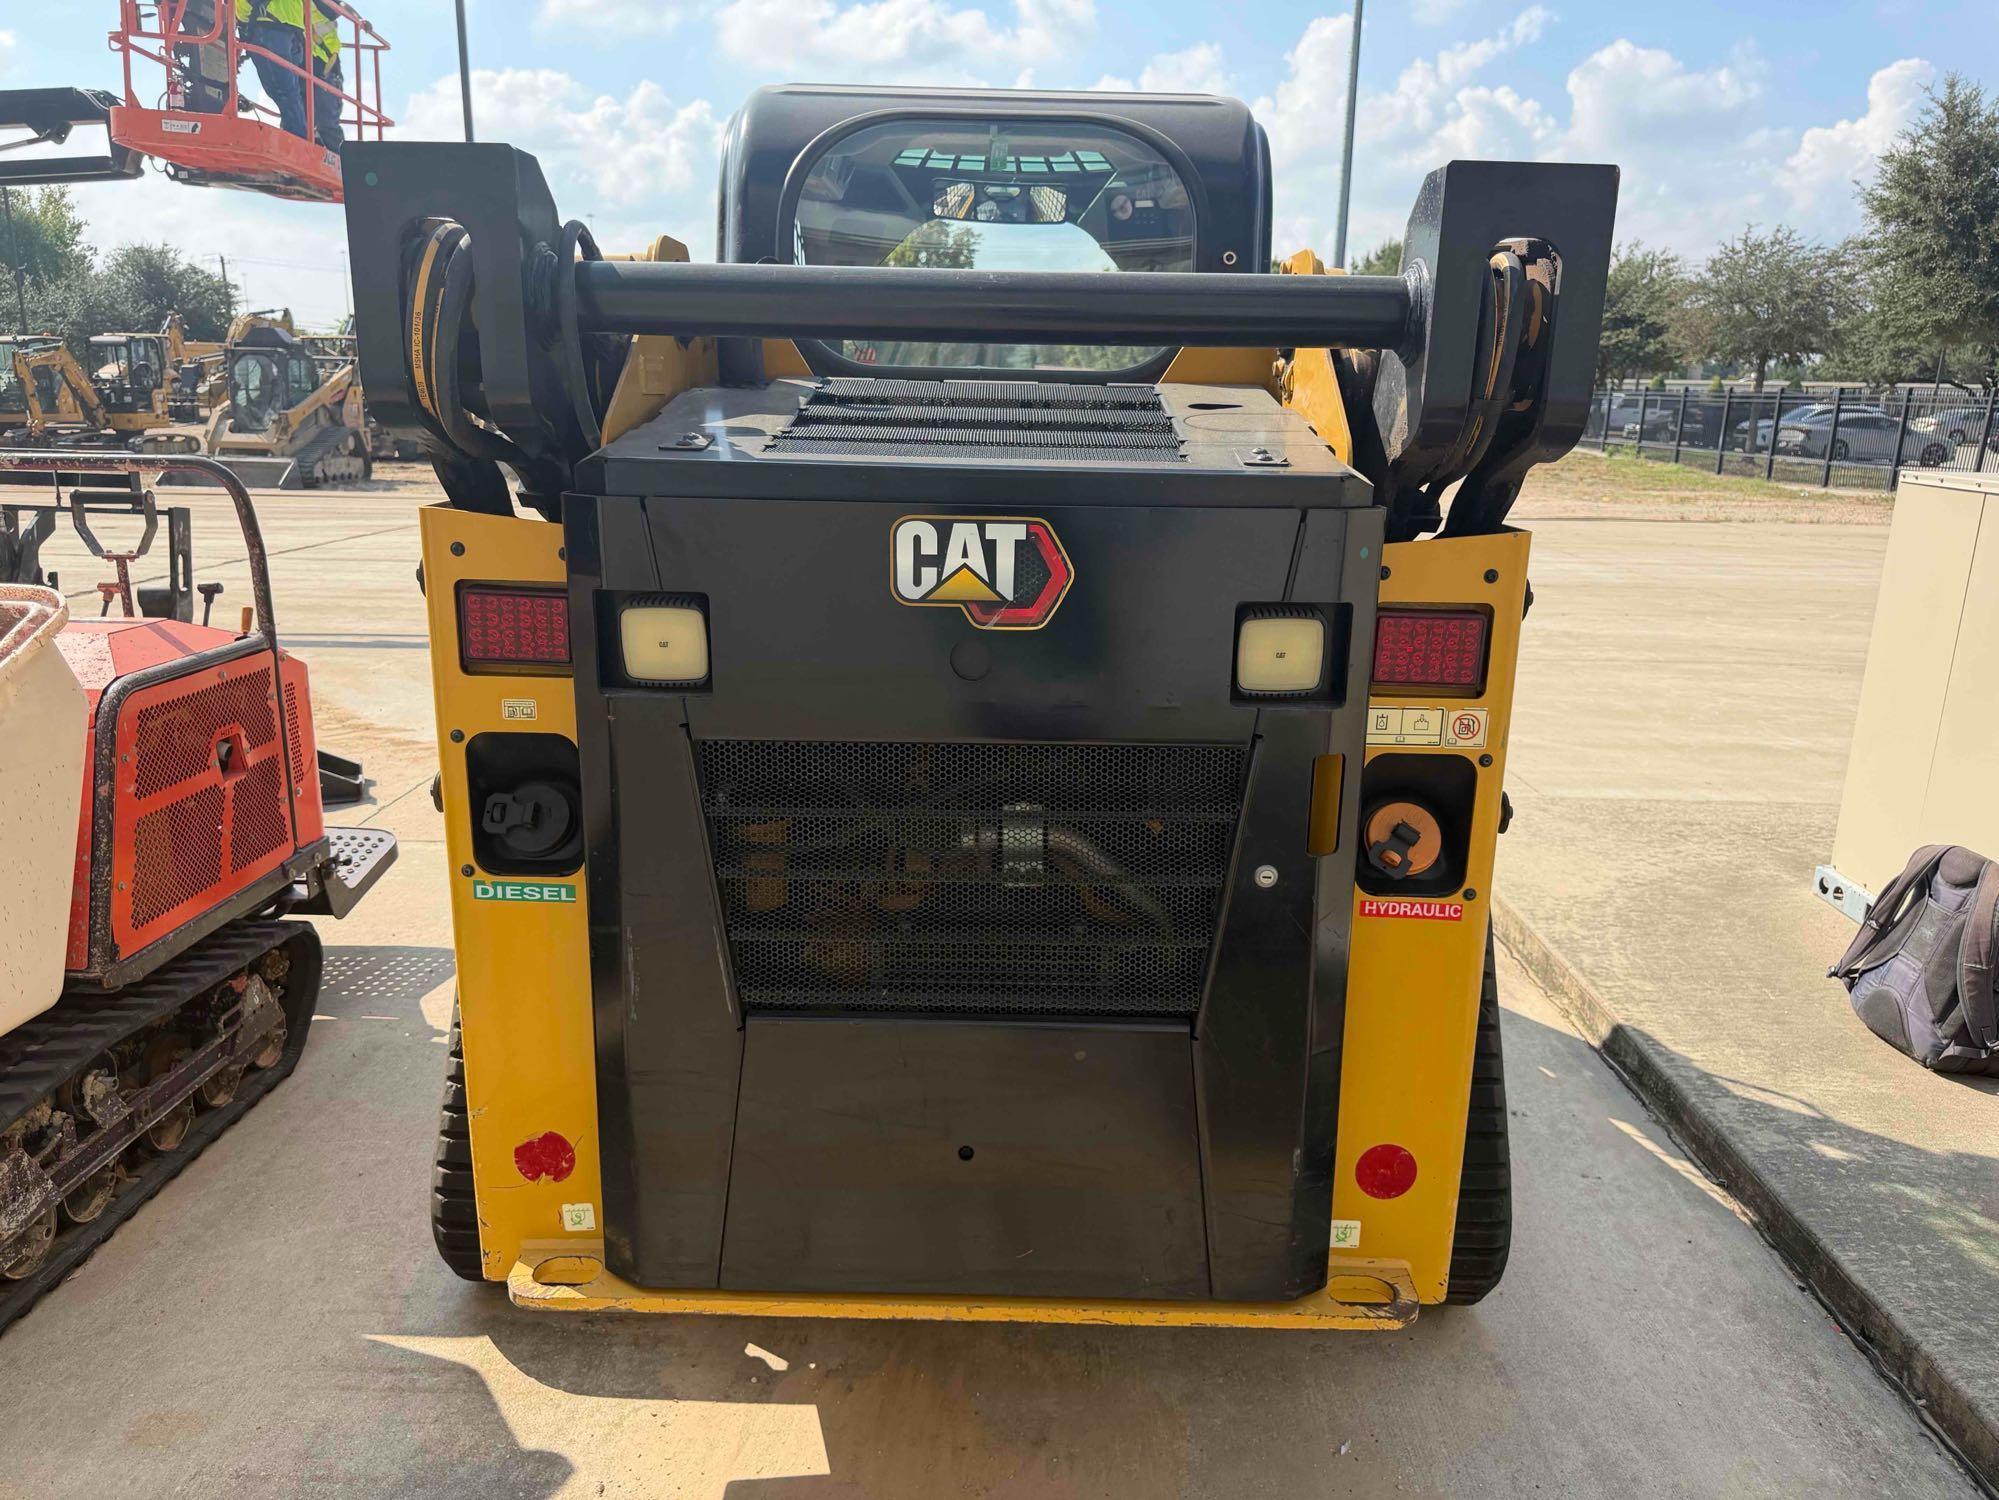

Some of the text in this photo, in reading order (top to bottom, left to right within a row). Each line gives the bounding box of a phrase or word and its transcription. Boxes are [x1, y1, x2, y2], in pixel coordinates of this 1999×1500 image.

[896, 520, 1027, 601] CAT
[475, 884, 577, 901] DIESEL
[1364, 901, 1462, 918] HYDRAULIC
